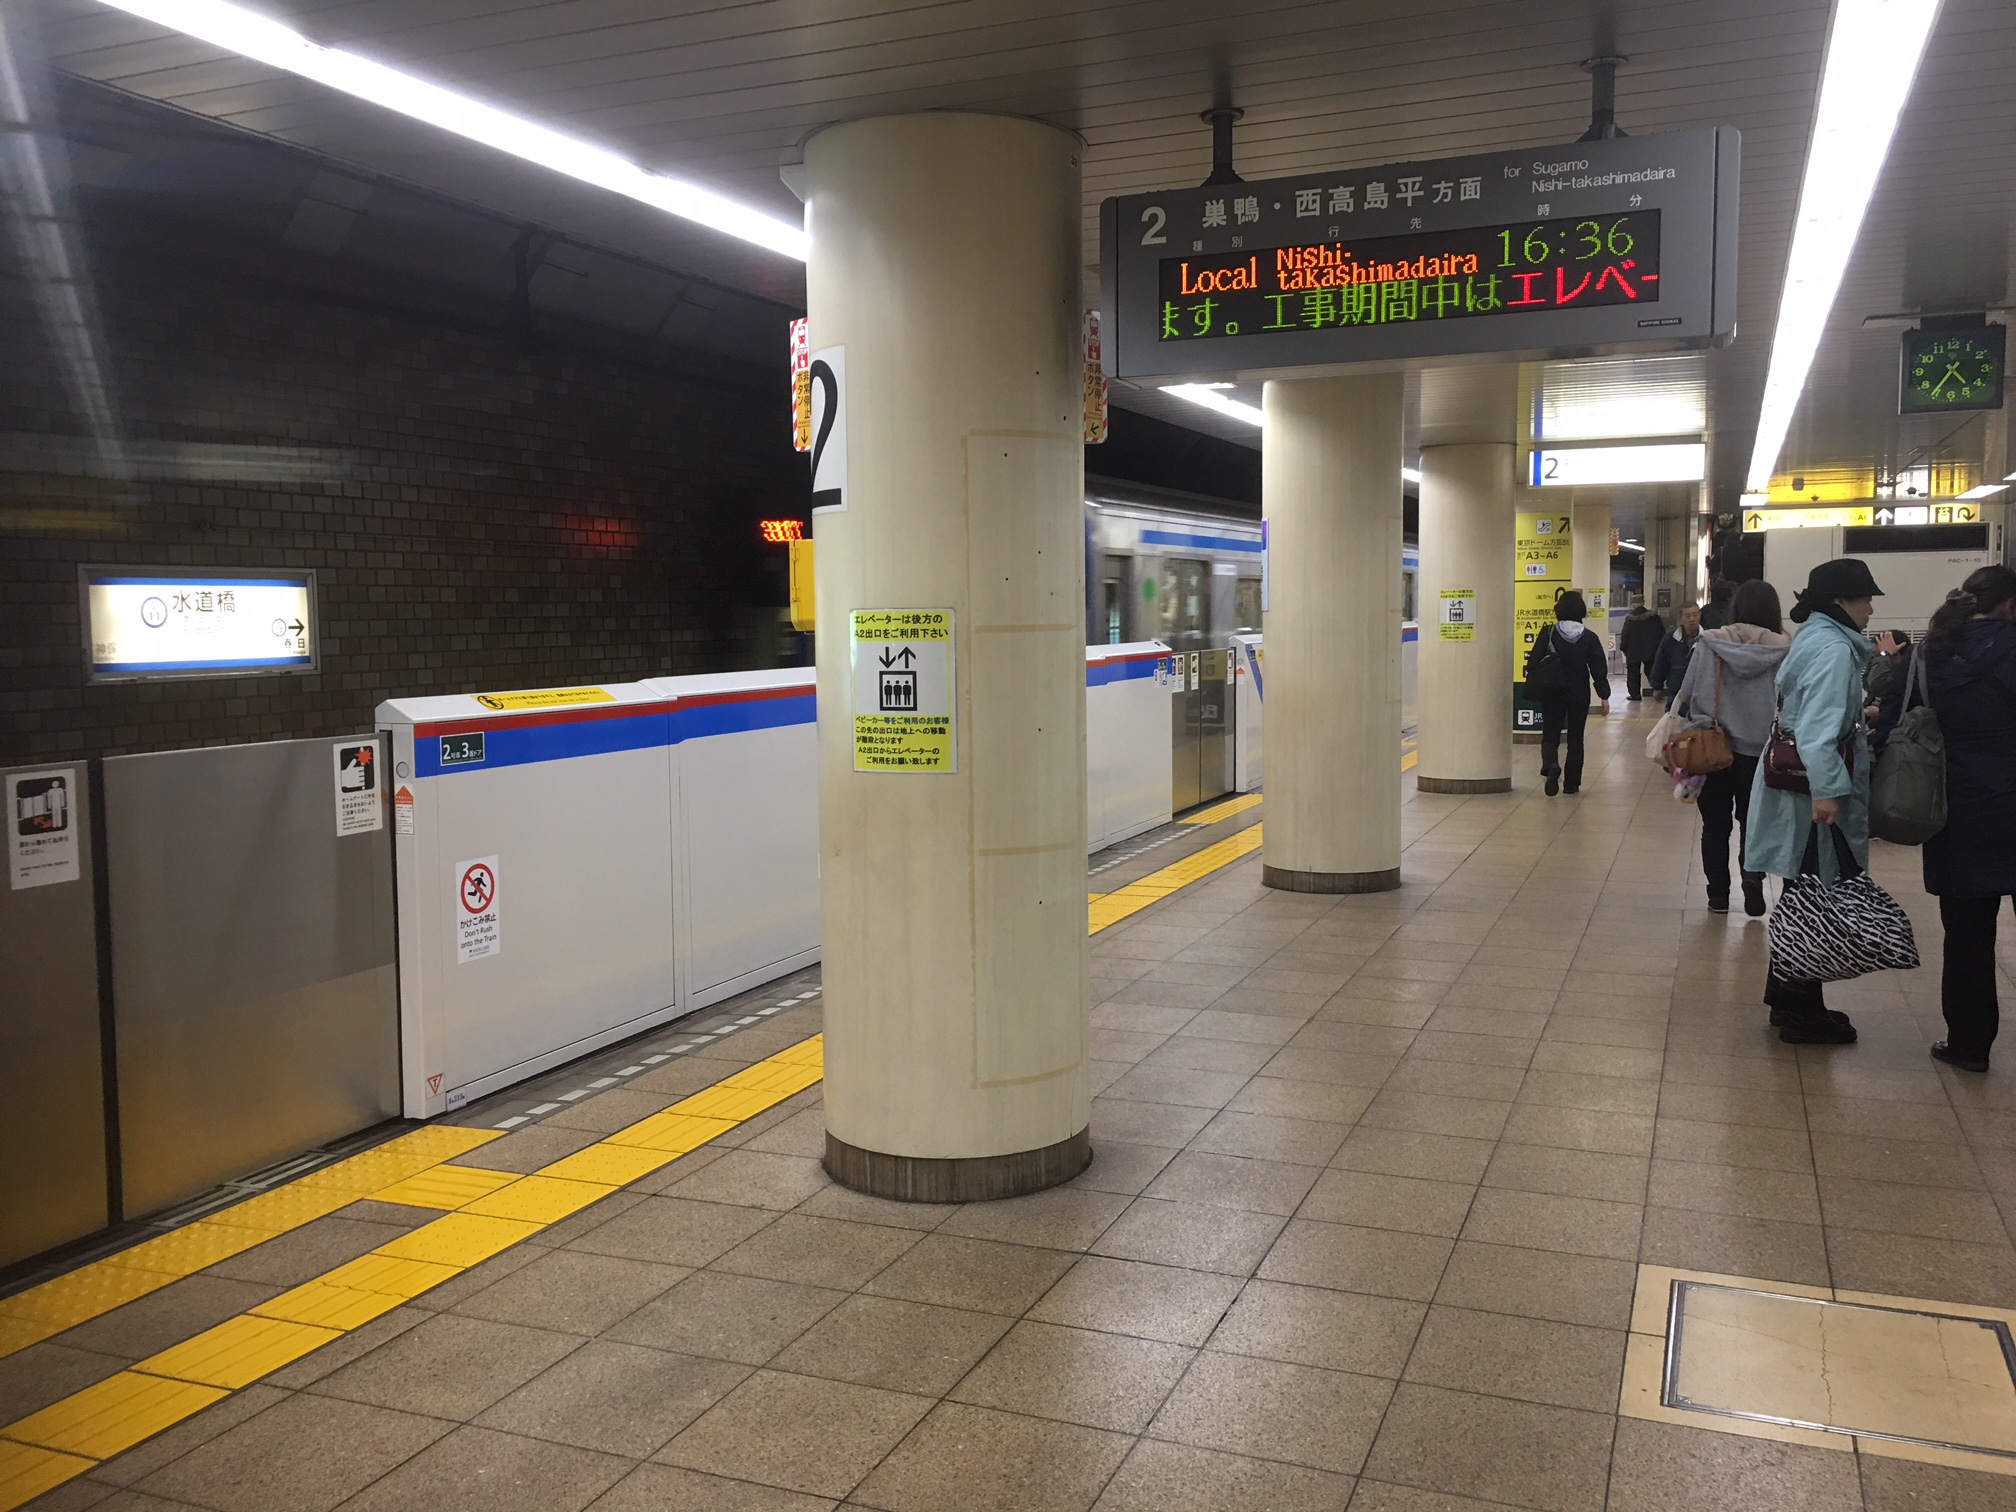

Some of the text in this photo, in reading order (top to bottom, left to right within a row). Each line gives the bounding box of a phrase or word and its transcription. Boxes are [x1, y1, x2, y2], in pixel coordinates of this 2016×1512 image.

[1504, 159, 1588, 178] for Sugamo
[1532, 167, 1676, 193] Nishi-takashimadaira
[1141, 206, 1167, 246] 2
[1497, 217, 1634, 268] 16:36
[1180, 256, 1258, 295] Local
[1277, 252, 1479, 291] takashimadaira
[1947, 340, 1960, 349] 12
[1921, 355, 1934, 364] 10
[1975, 351, 1984, 359] 2
[1915, 367, 1924, 376] 9
[1981, 364, 1990, 373] 3
[1921, 380, 1930, 389] 8
[1973, 378, 1983, 386] 4
[1946, 390, 1955, 400] 6
[1961, 387, 1970, 395] 5
[810, 359, 842, 510] 2
[1544, 457, 1559, 480] 2
[173, 590, 235, 613] 水道橋
[855, 614, 943, 625] エレベーターは後方の
[855, 628, 948, 639] A2出口をご利用下さい
[460, 912, 497, 929] かけこみ禁止
[464, 925, 493, 938] Don't Rush
[460, 940, 473, 949] onto
[484, 934, 497, 942] Train
